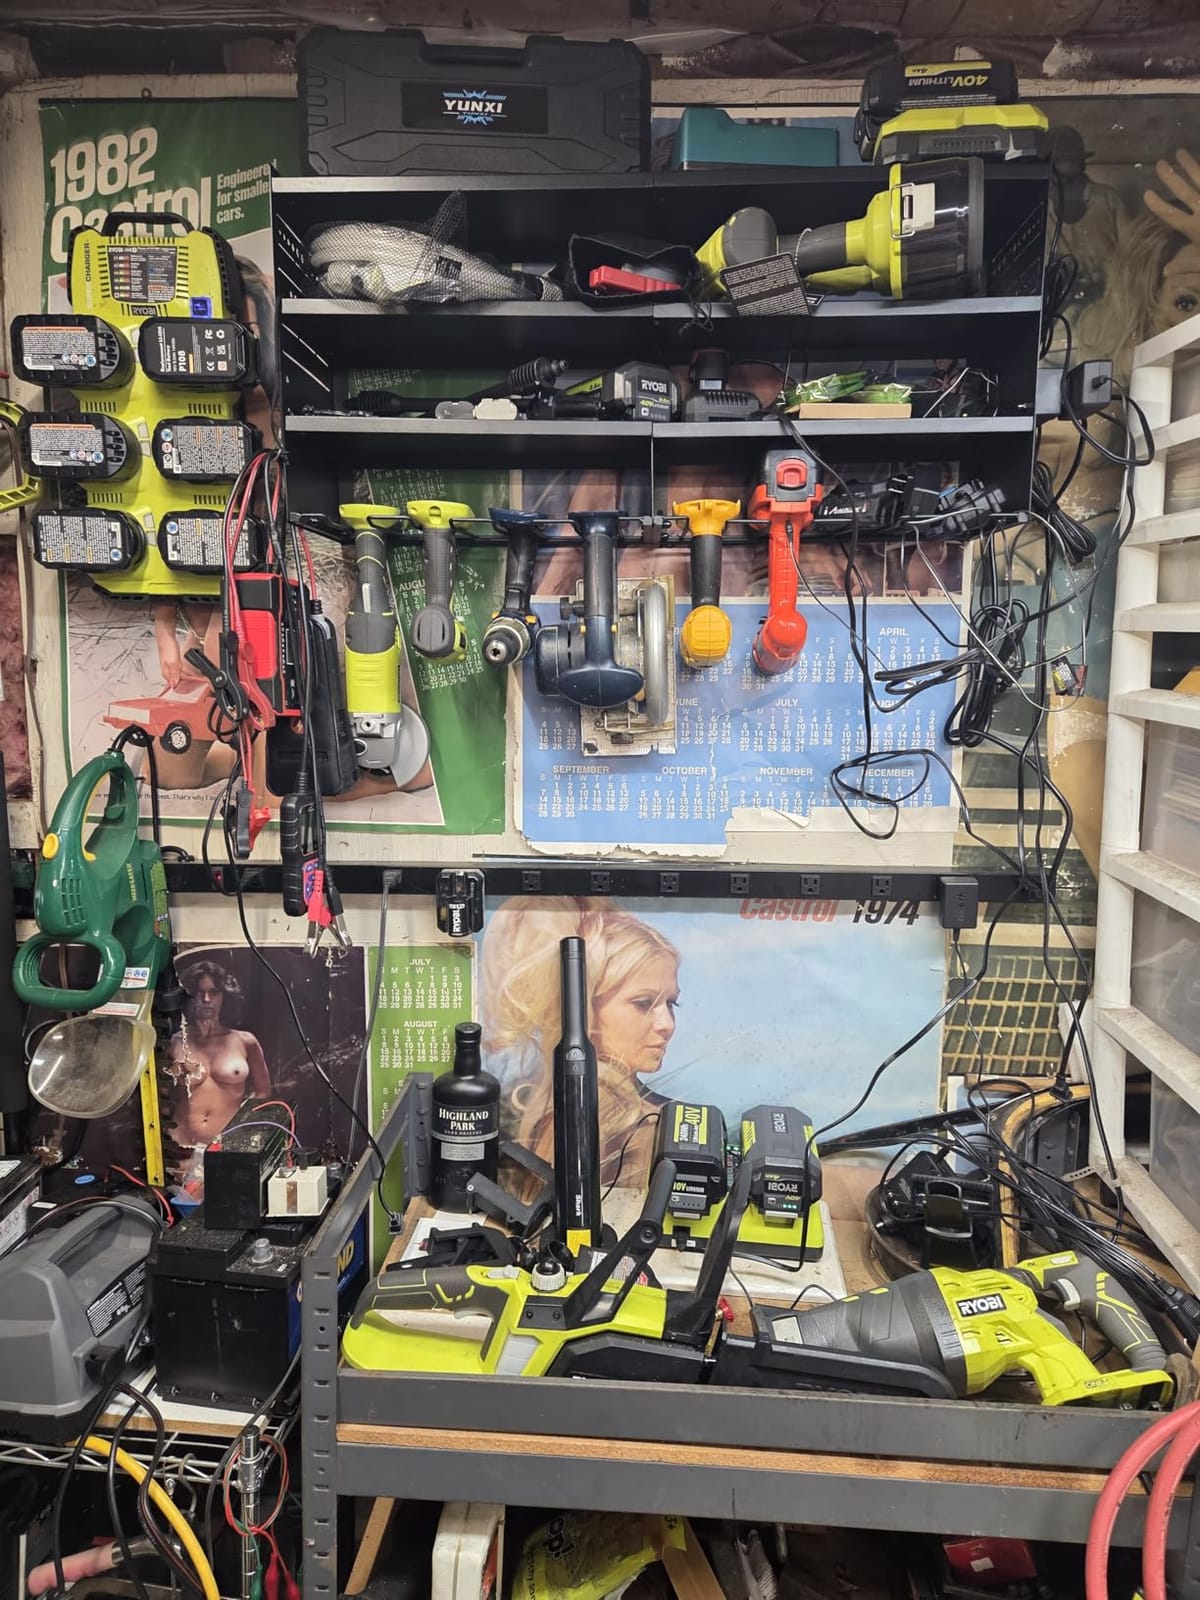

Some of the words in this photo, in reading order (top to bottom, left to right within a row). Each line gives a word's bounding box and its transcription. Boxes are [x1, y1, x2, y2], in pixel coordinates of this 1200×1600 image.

[908, 76, 954, 86] LITHIUM
[952, 76, 988, 87] 40V
[444, 100, 502, 113] YUNXI
[50, 127, 158, 206] 1982
[216, 192, 232, 206] for
[234, 180, 270, 202] smalle
[216, 206, 244, 224] cars.
[132, 307, 156, 315] RYOBI
[178, 350, 186, 372] P108
[641, 379, 667, 393] RYOBI
[399, 580, 426, 591] AUGU
[880, 628, 908, 636] APRIL
[553, 765, 610, 774] SEPTEMBER
[662, 767, 707, 775] OCTOBER
[760, 767, 813, 775] NOVEMBER
[739, 898, 840, 924] Castrol
[853, 900, 920, 926] 1974
[439, 1108, 489, 1120] HIGHLAND
[684, 1106, 701, 1125] 40V
[450, 1121, 476, 1130] PARK
[768, 1182, 798, 1192] RYOBI
[958, 1295, 1004, 1315] RYOBI
